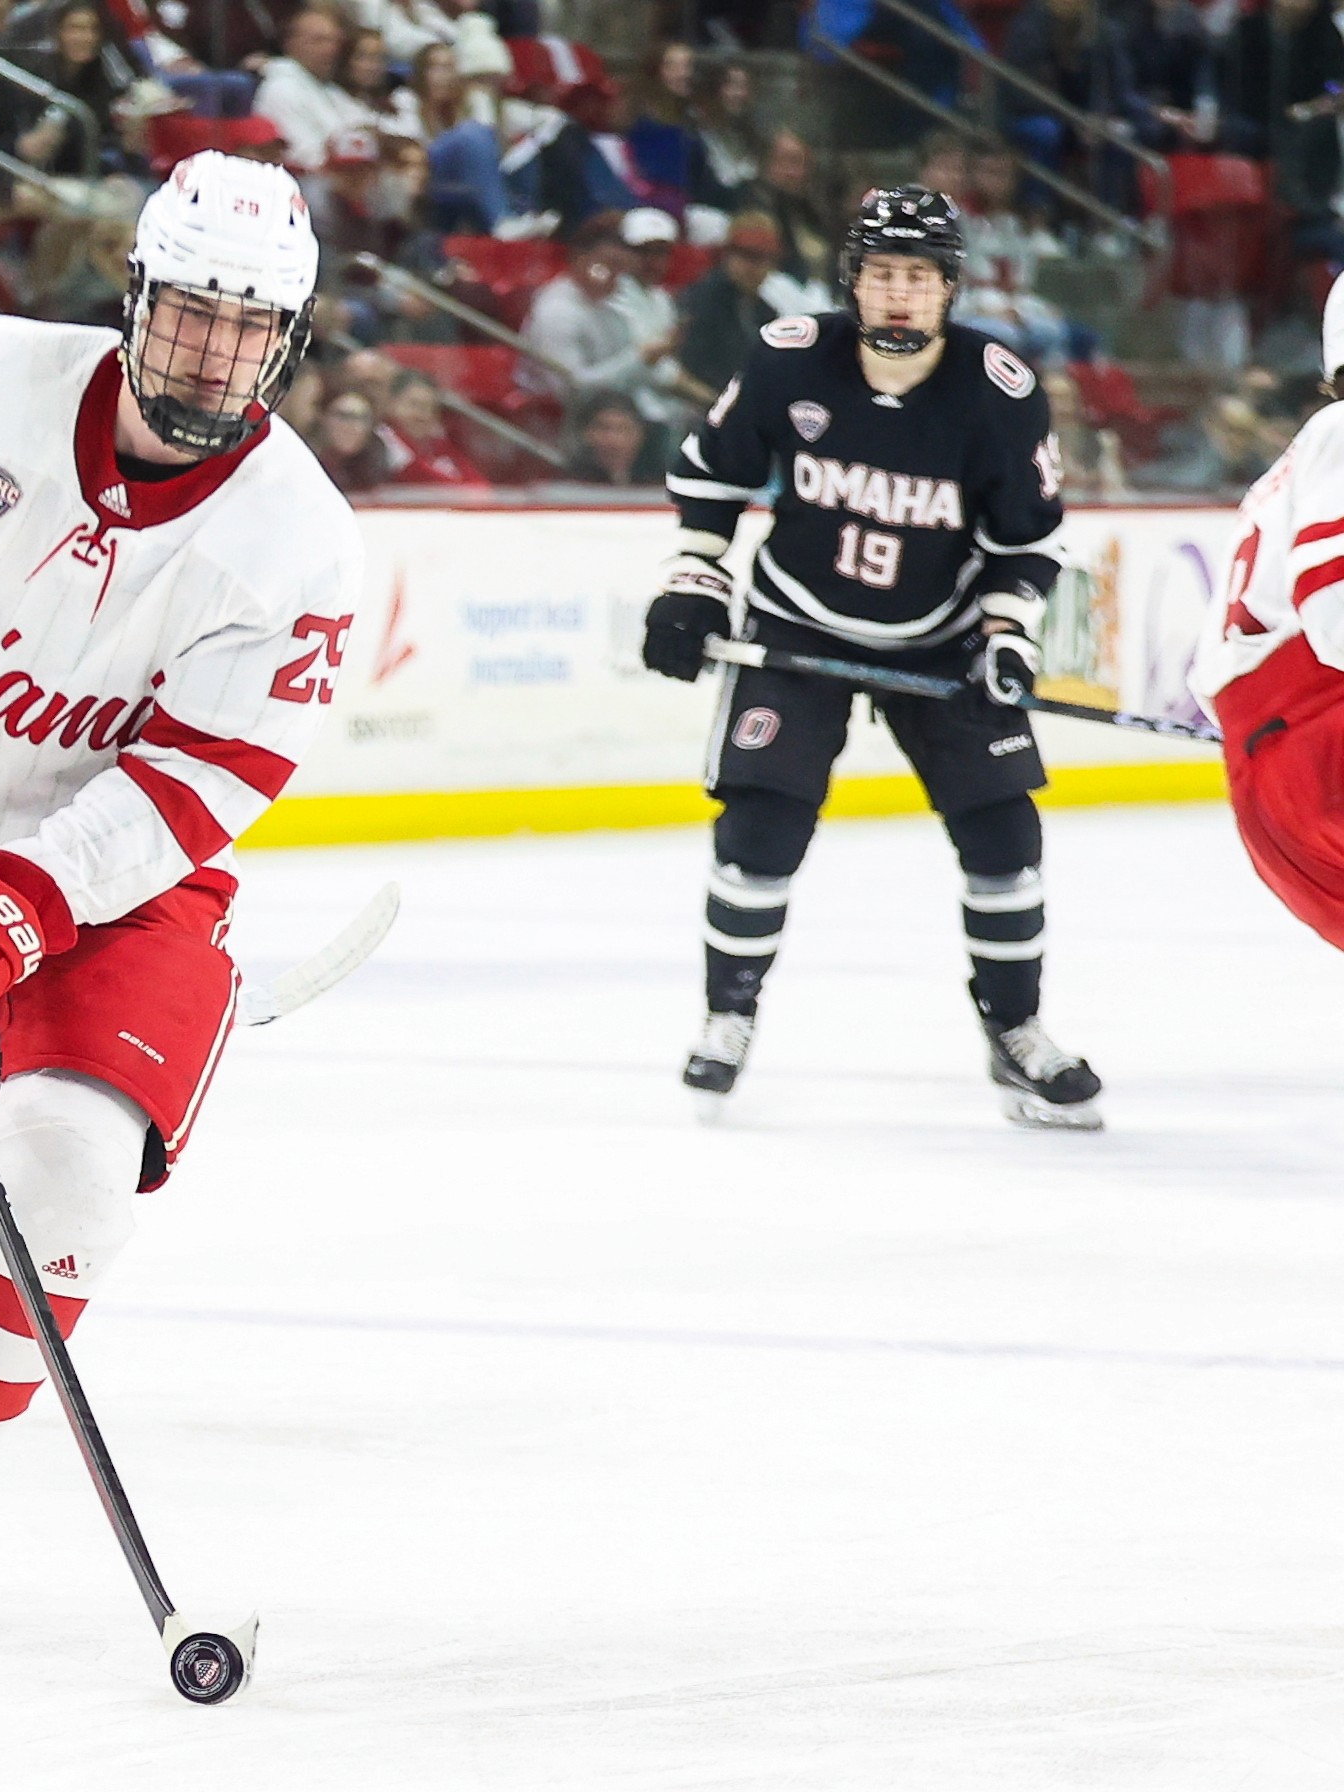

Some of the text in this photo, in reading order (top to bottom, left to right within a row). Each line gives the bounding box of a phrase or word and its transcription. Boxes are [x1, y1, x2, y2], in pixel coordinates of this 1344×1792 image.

[794, 451, 965, 531] OMAHA
[833, 521, 904, 590] 19
[42, 1263, 79, 1280] adidas
